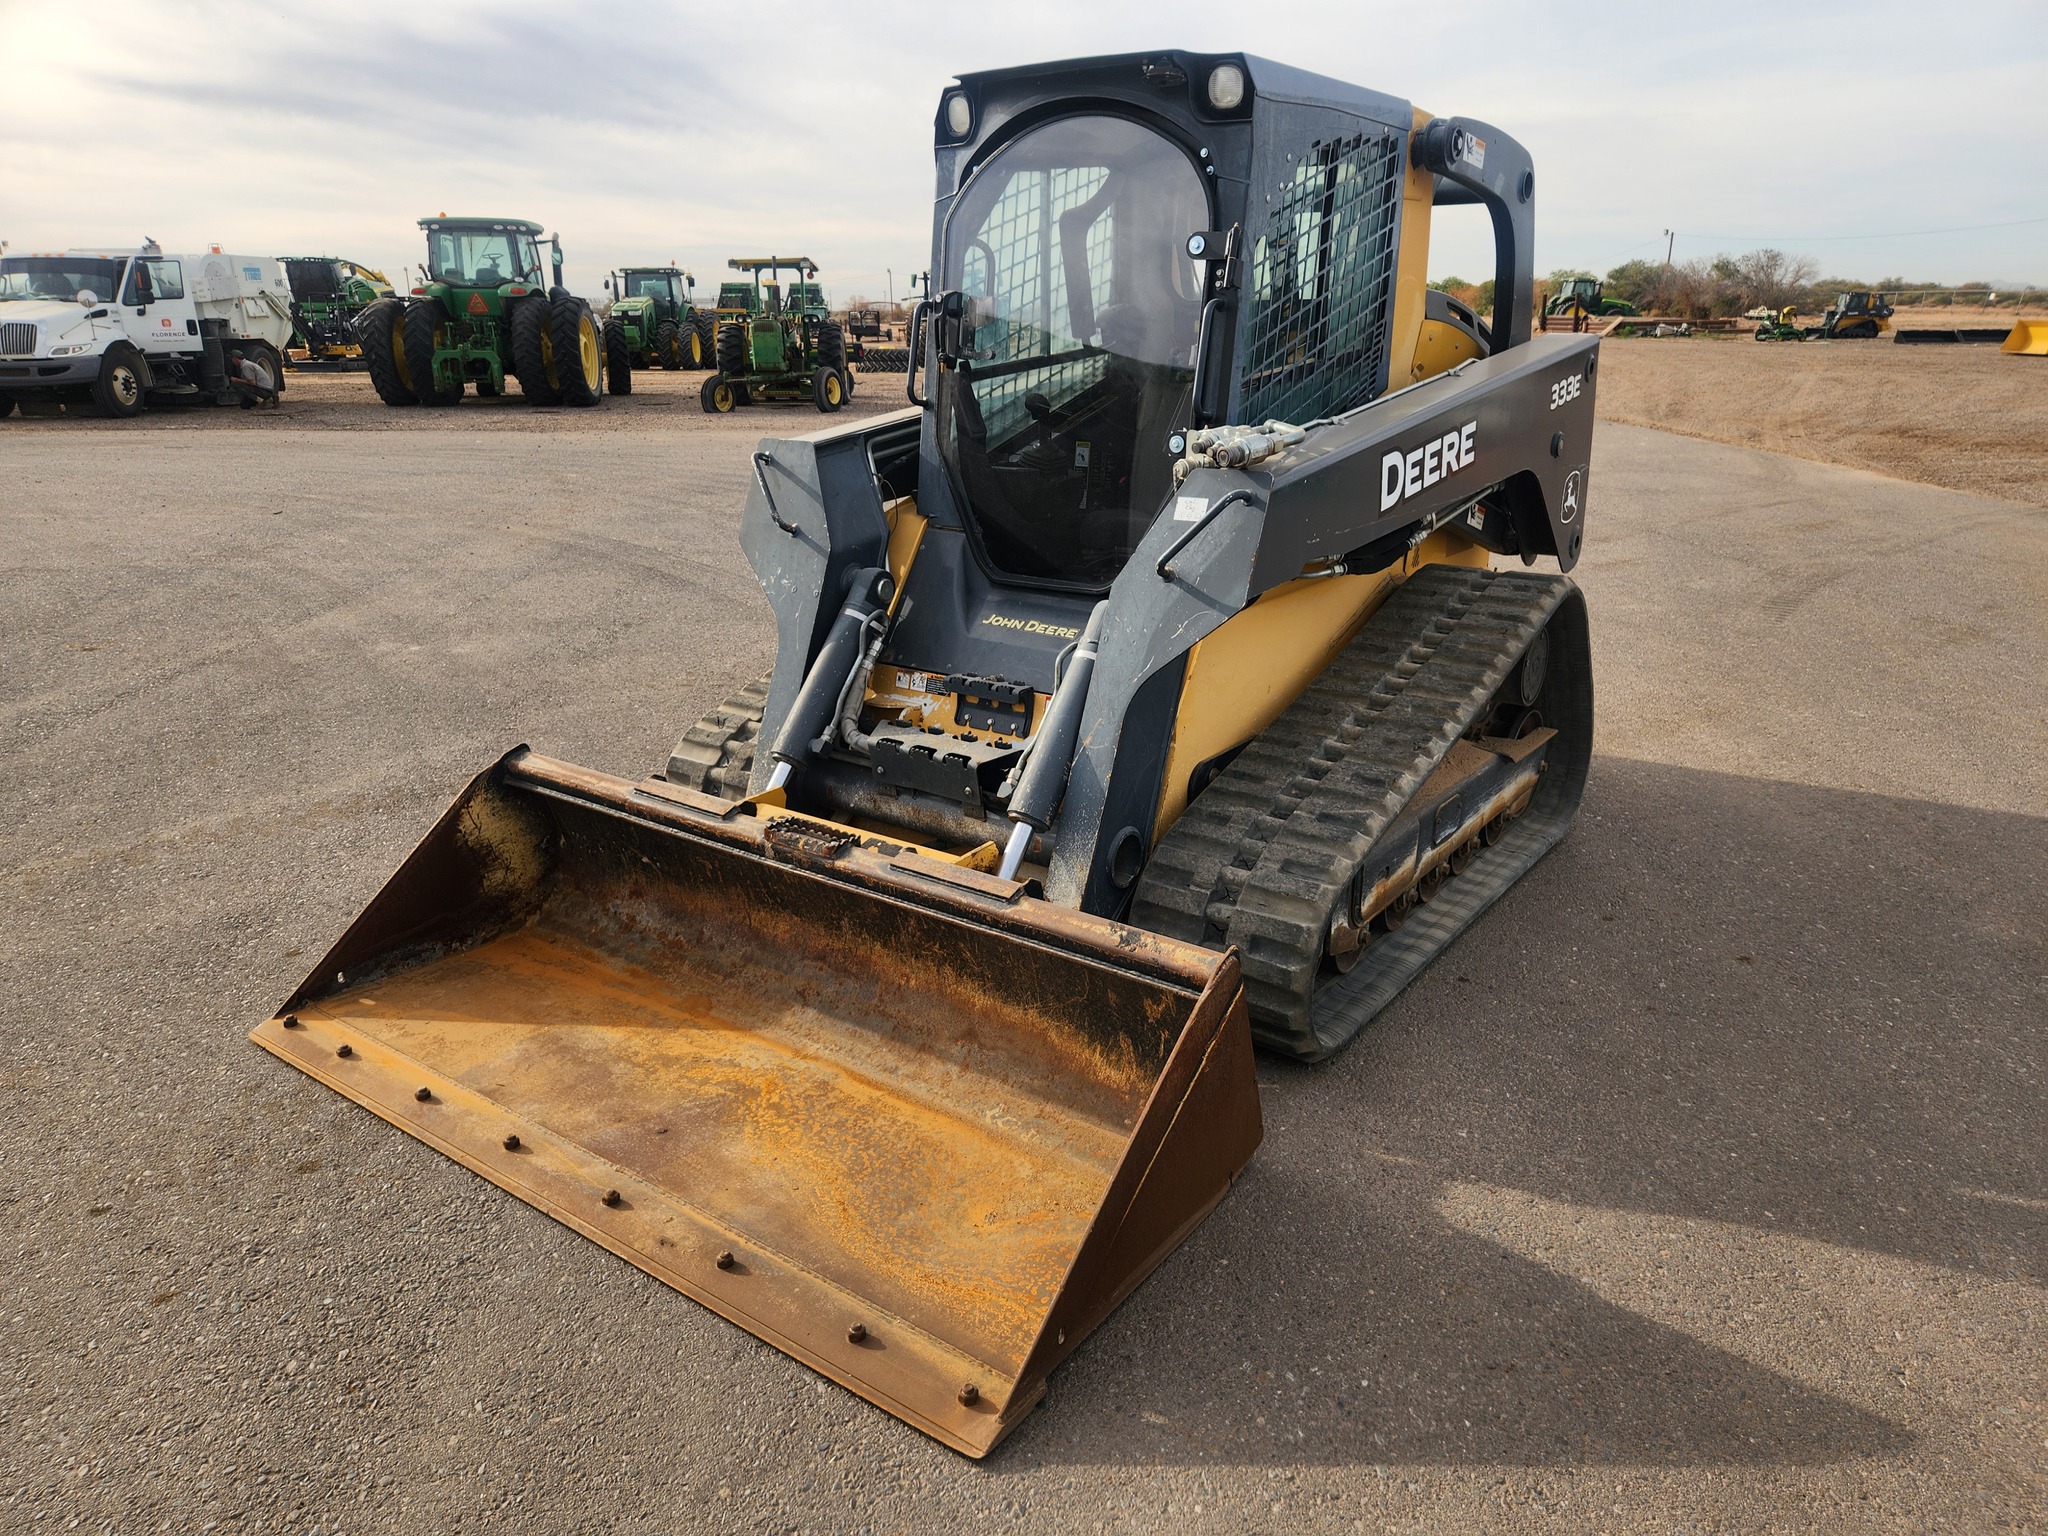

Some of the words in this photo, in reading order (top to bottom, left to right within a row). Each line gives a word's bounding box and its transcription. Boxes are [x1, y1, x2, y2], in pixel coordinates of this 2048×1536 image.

[1550, 373, 1582, 411] 333E
[1380, 420, 1478, 513] DEERE
[982, 613, 1026, 630] JOHN
[1024, 620, 1080, 639] DEERE
